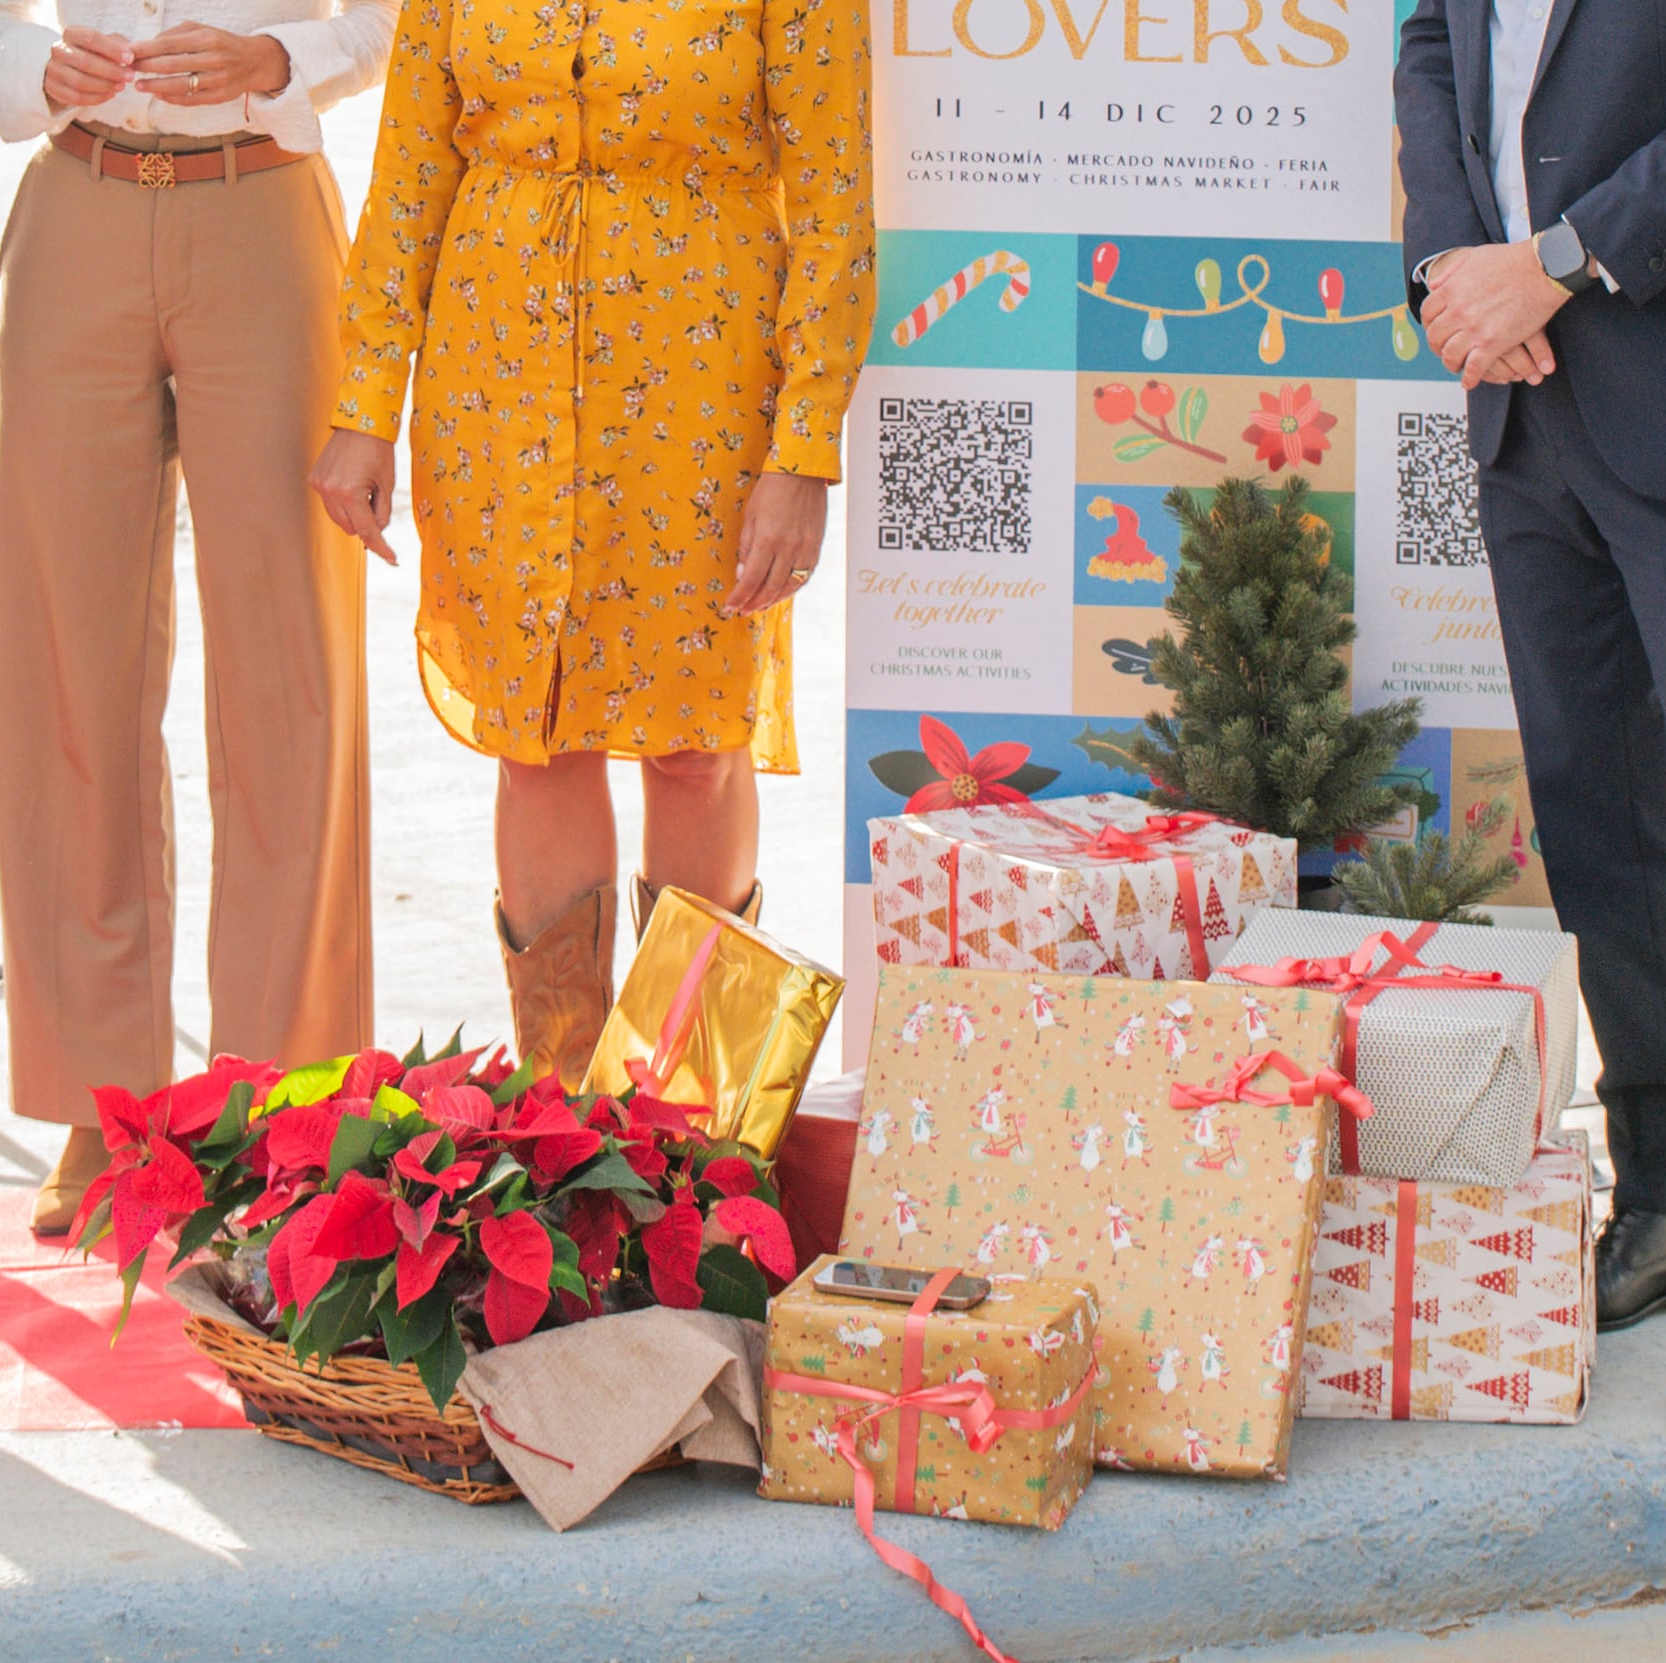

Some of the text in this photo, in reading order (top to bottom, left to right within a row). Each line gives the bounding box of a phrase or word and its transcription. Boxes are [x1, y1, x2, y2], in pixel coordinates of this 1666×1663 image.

[936, 97, 962, 119] 11
[1038, 100, 1073, 122] 14
[1106, 103, 1176, 124] DIC
[1209, 104, 1307, 127] 2025
[910, 149, 1329, 172] GASTRONOMÍA MERCADO NAVIDEÑO FERIA
[906, 170, 1341, 192] GASTRONOMY CHRISTMAS MARKET FAIR
[922, 569, 1047, 599] celebrate
[1391, 585, 1494, 613] Celebre
[893, 600, 1005, 631] together
[897, 646, 1004, 661] DISCOVER OUR
[870, 663, 1032, 680] CHRISTMAS ACTIVITIES
[1391, 661, 1507, 676] DESCUBRE NUES
[1380, 678, 1511, 695] ACTIVIDADES NAVI
